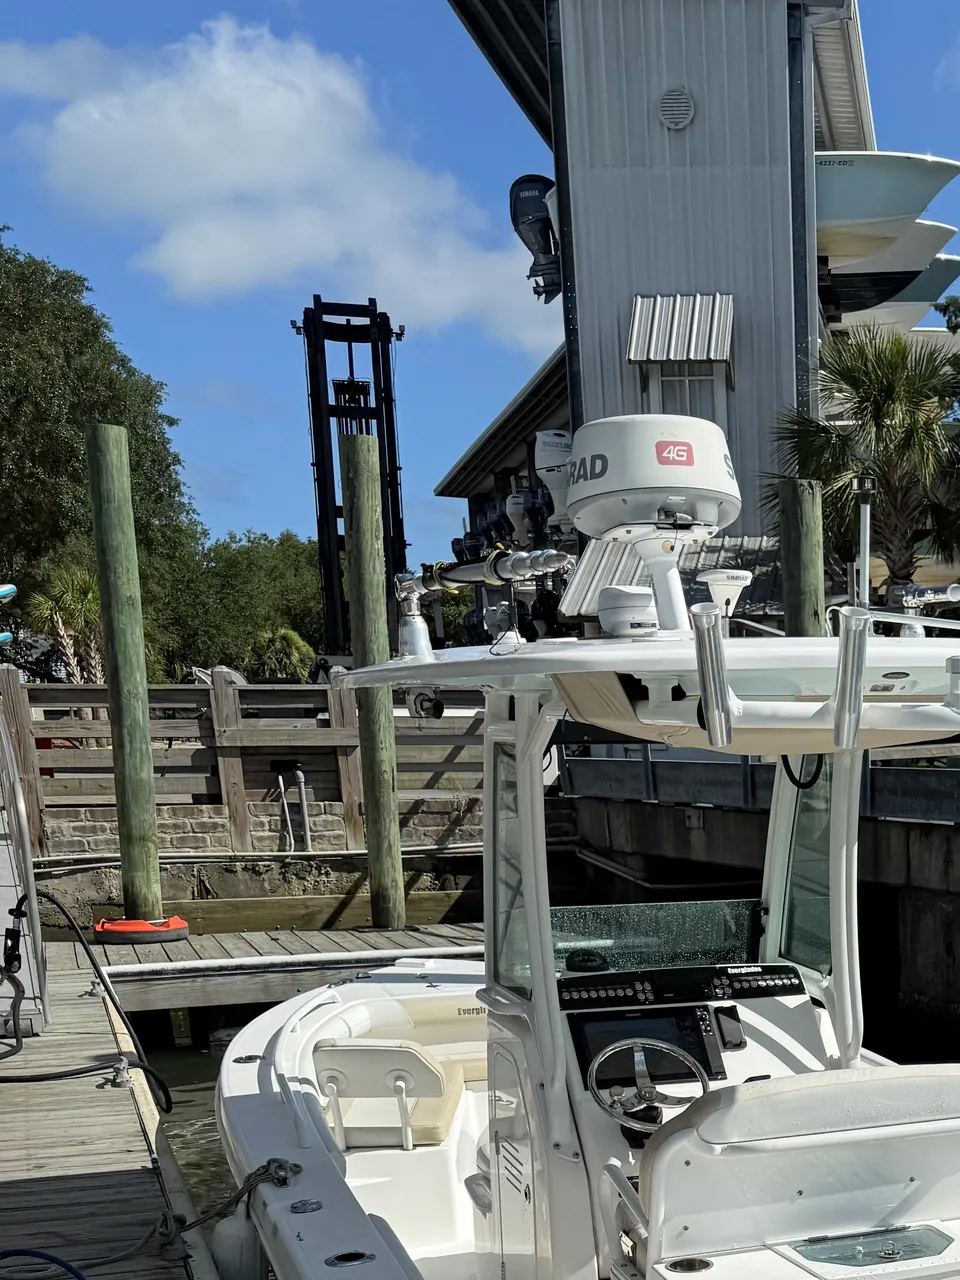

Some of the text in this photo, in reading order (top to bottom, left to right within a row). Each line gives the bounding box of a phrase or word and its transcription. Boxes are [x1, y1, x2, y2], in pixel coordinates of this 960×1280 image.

[519, 189, 539, 198] YAMAHA
[662, 445, 688, 461] 4G
[567, 453, 609, 487] RAD
[727, 966, 762, 974] Everglades
